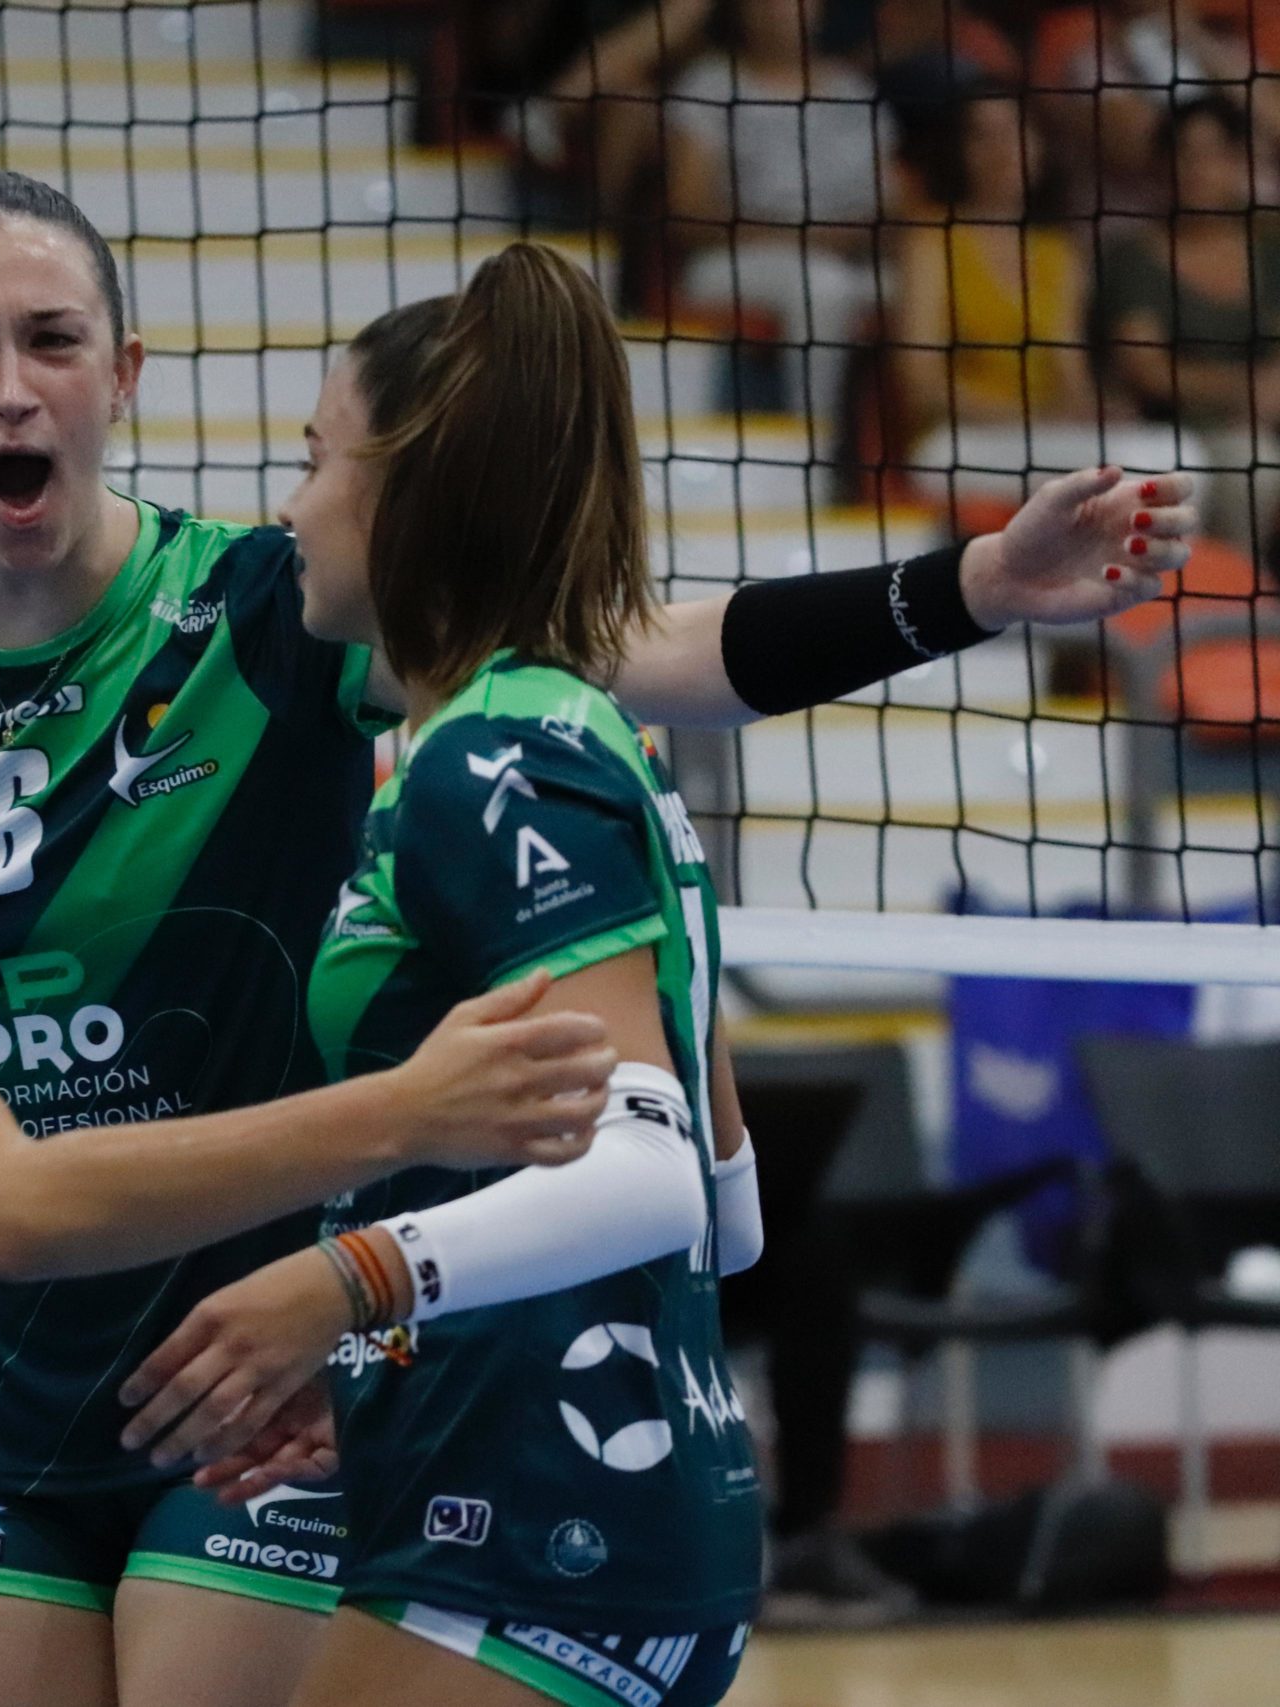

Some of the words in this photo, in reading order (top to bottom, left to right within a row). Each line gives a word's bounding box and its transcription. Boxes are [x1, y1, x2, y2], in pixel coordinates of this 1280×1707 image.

[136, 761, 216, 798] Esquimo
[21, 1091, 193, 1140] OFESIONAL
[265, 1509, 348, 1538] Esquimo
[204, 1533, 311, 1573] emec
